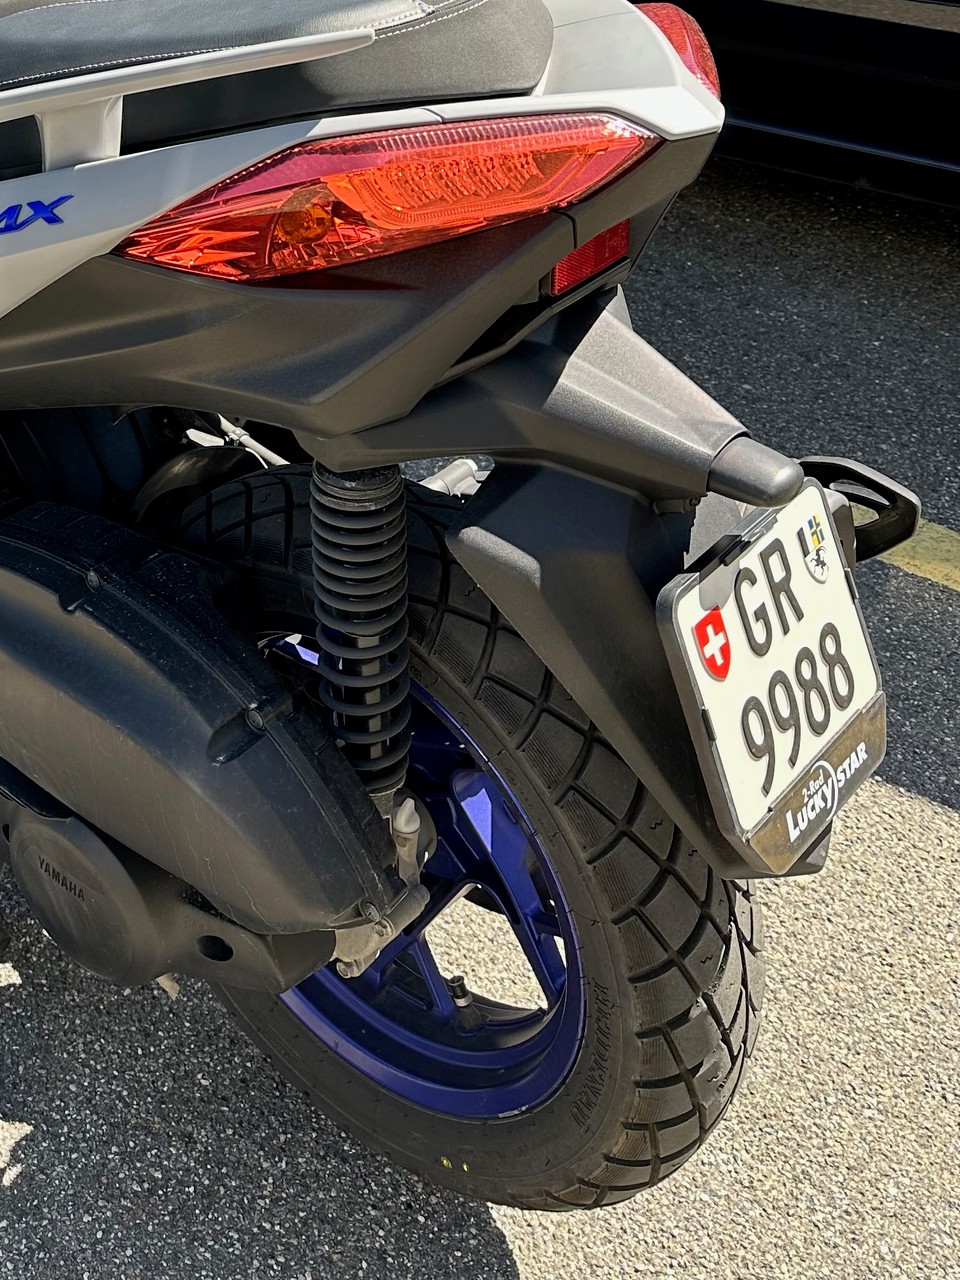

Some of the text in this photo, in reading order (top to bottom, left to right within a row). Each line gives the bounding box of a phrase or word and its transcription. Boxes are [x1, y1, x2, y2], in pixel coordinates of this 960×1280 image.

[734, 537, 804, 658] GR
[740, 621, 855, 797] 9988
[836, 741, 868, 788] STAR
[38, 855, 85, 902] YAMAHA
